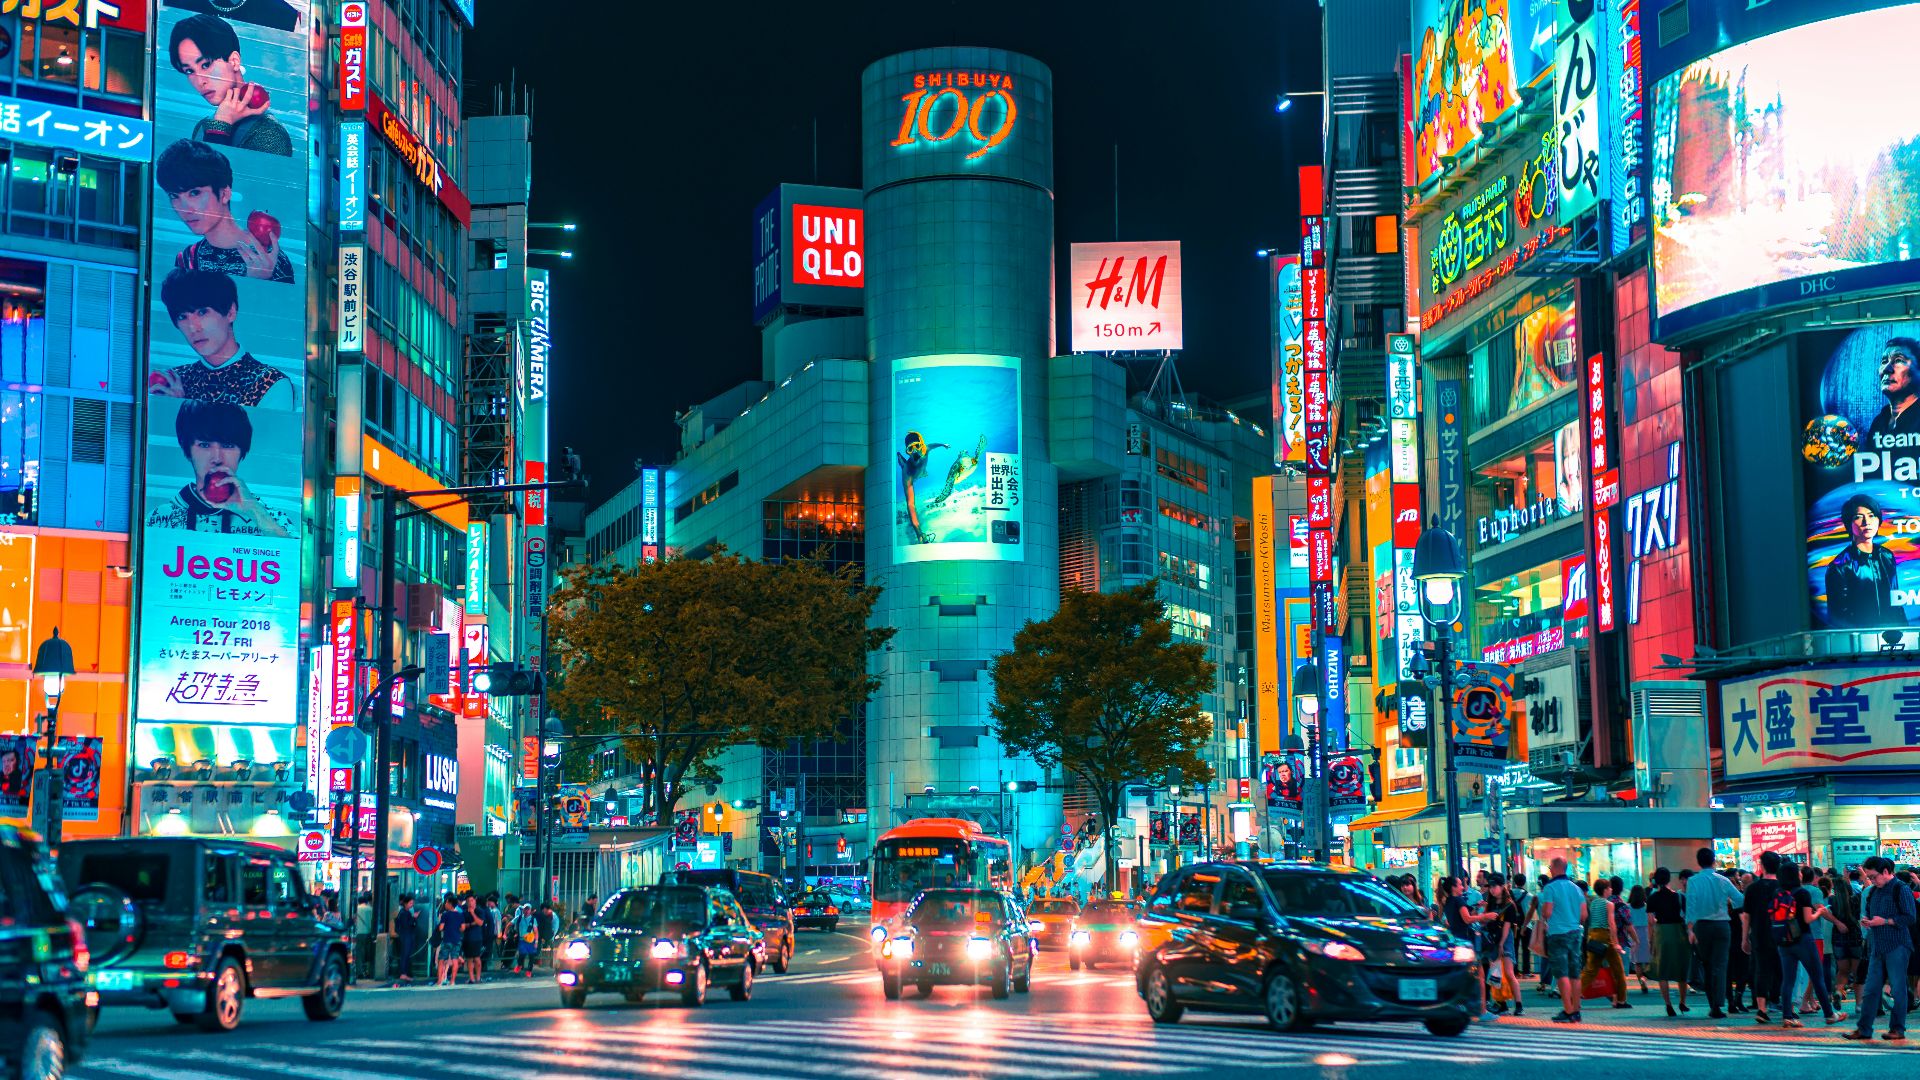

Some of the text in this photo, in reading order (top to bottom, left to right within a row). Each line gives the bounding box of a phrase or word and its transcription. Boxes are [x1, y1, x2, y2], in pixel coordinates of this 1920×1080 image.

[345, 49, 362, 98] ガスト
[913, 73, 1014, 90] SHIBUYA
[1558, 0, 1599, 198] んじゃ
[890, 86, 1018, 160] 109
[346, 133, 360, 220] 英会話イーオン
[416, 144, 443, 196] ガスト
[345, 222, 357, 230] 6F
[760, 207, 775, 257] THE
[802, 215, 856, 246] UNI
[1464, 197, 1507, 270] 西村
[755, 248, 779, 307] PRIME
[802, 247, 862, 280] QLO
[343, 252, 358, 343] 渋谷駅前ビル
[530, 280, 545, 312] BIC
[1085, 255, 1168, 310] H&M
[1800, 277, 1836, 296] DHC
[1094, 323, 1143, 337] 150m
[1592, 362, 1605, 468] お好み焼
[1401, 423, 1409, 472] Euphoria
[990, 465, 1019, 476] 世界に
[1313, 479, 1323, 487] 6F
[1854, 451, 1920, 483] Pla
[1396, 509, 1418, 524] JTB
[1477, 495, 1554, 545] Euphoria
[1626, 480, 1679, 558] クスリ
[252, 549, 281, 557] SINGLE
[1314, 532, 1325, 540] 6F
[163, 546, 281, 584] Jesus
[468, 527, 481, 603] レイクALSA
[528, 537, 546, 618] OS 調剤薬局
[1259, 514, 1273, 633] Matsumoto KiYoshi
[1400, 568, 1409, 599] パーラー
[1565, 562, 1586, 611] JT
[170, 615, 271, 631] Arena Tour 2018
[192, 629, 253, 648] 12.7 FRI
[159, 648, 279, 663] さいたまスーパーアリーナ
[1402, 632, 1411, 665] フルーツ
[166, 671, 268, 706] 超特急
[336, 635, 351, 715] サンドラッグ
[1327, 649, 1339, 699] MIZUHO
[468, 702, 478, 710] 3F
[1407, 696, 1426, 732] HUB
[1465, 747, 1495, 757] Tik Tok
[426, 754, 458, 795] LUSH
[152, 789, 290, 804] 渋谷駅前ビル
